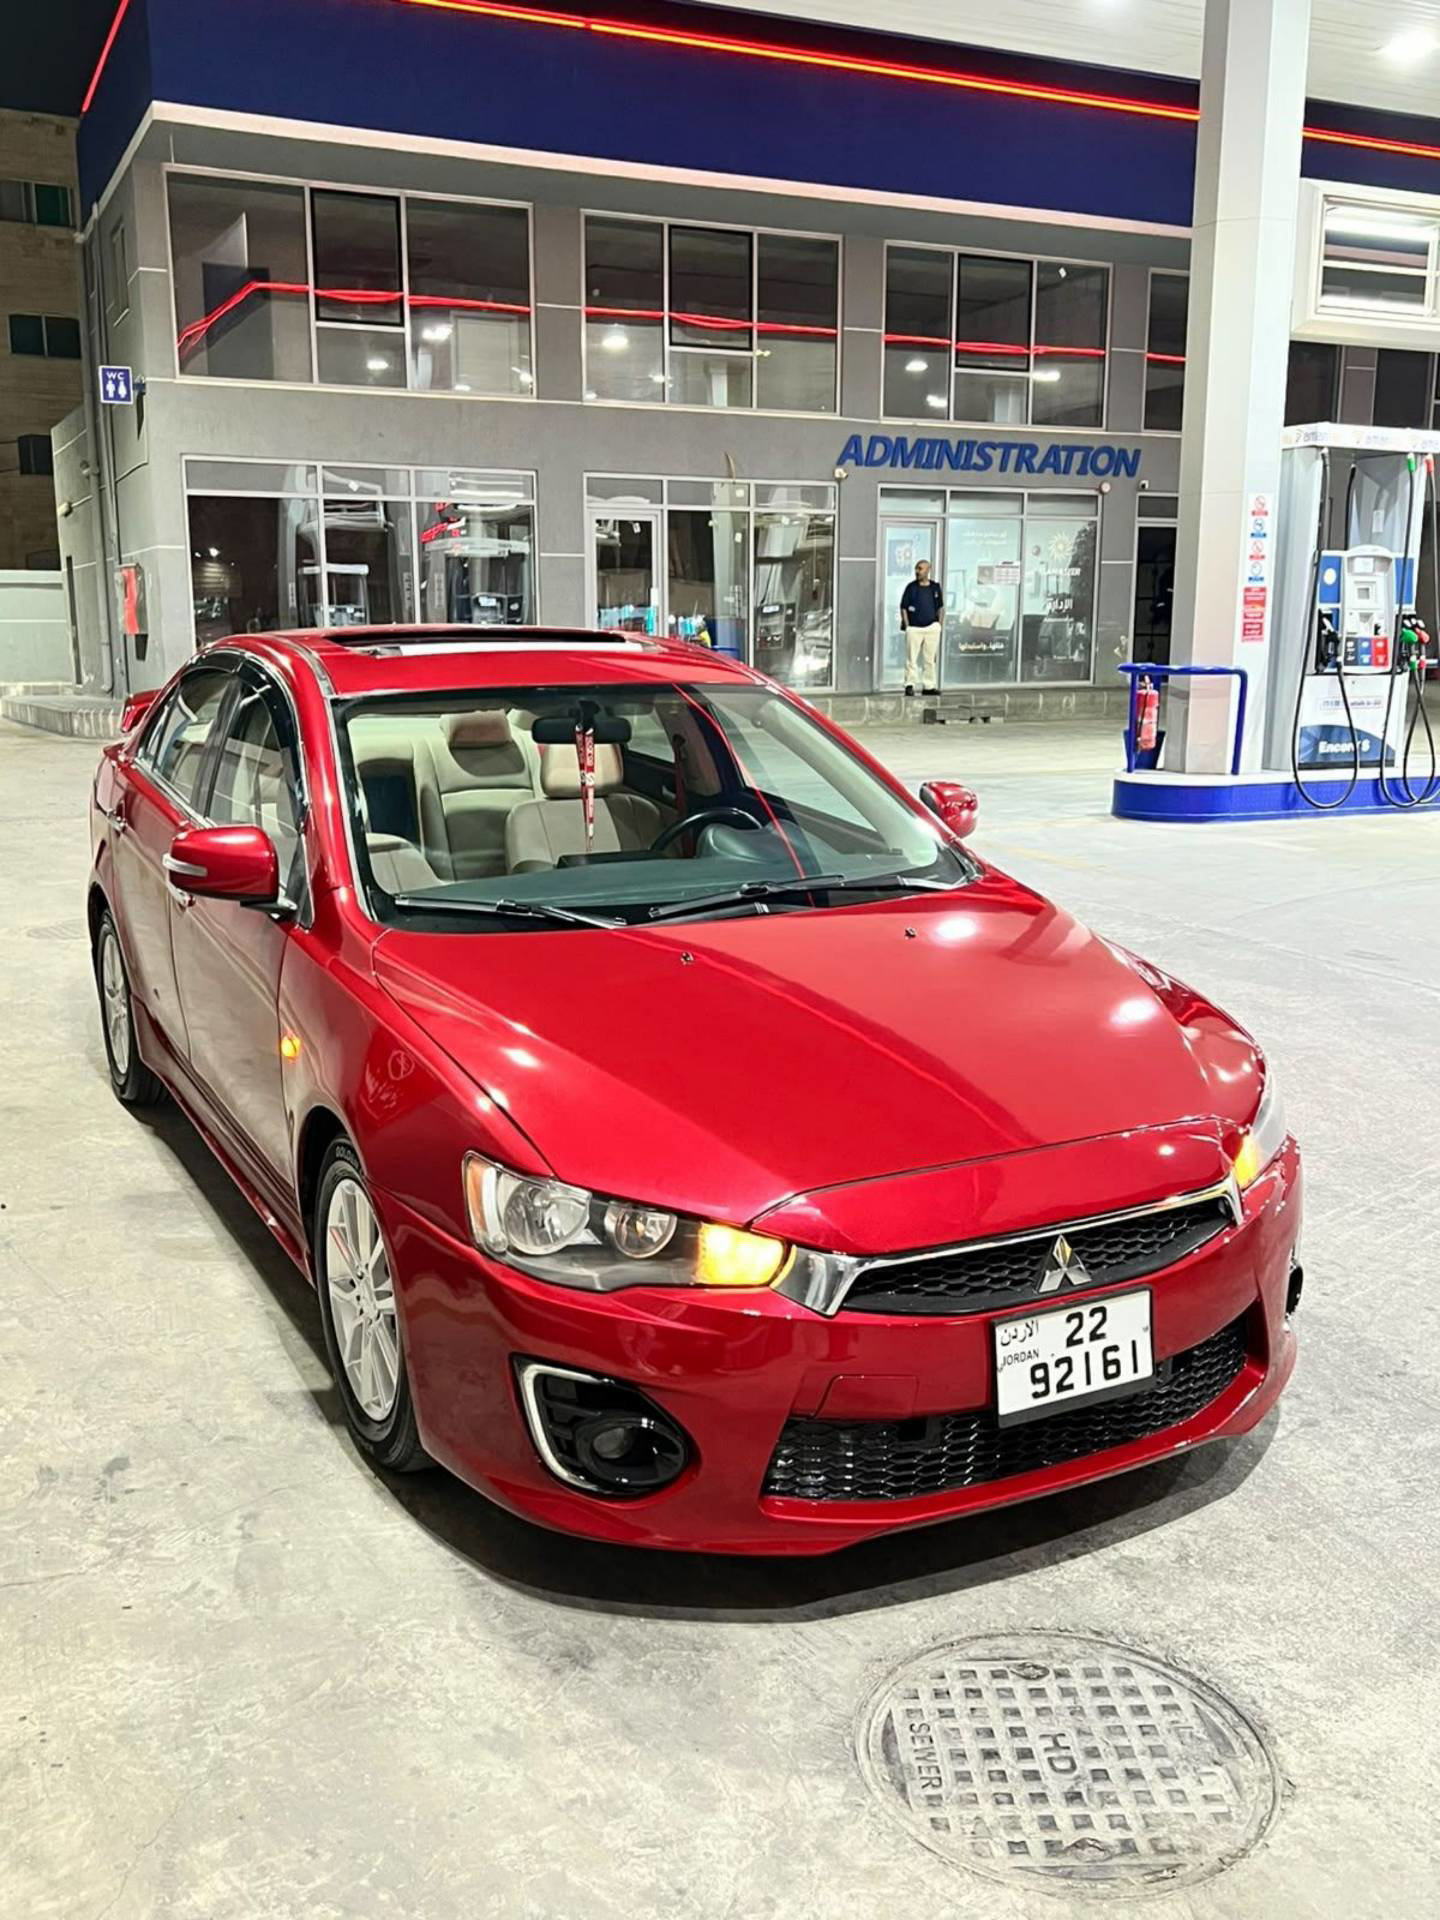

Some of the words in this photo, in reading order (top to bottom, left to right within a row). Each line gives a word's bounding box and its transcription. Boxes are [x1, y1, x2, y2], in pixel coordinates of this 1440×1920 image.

[106, 371, 125, 380] WC
[838, 434, 1141, 478] ADMINISTRATION
[1066, 1306, 1107, 1348] 22
[1001, 1348, 1040, 1367] JORDAN
[1030, 1340, 1138, 1399] 92161
[909, 1723, 942, 1789] SEWER
[1039, 1733, 1077, 1774] HD
